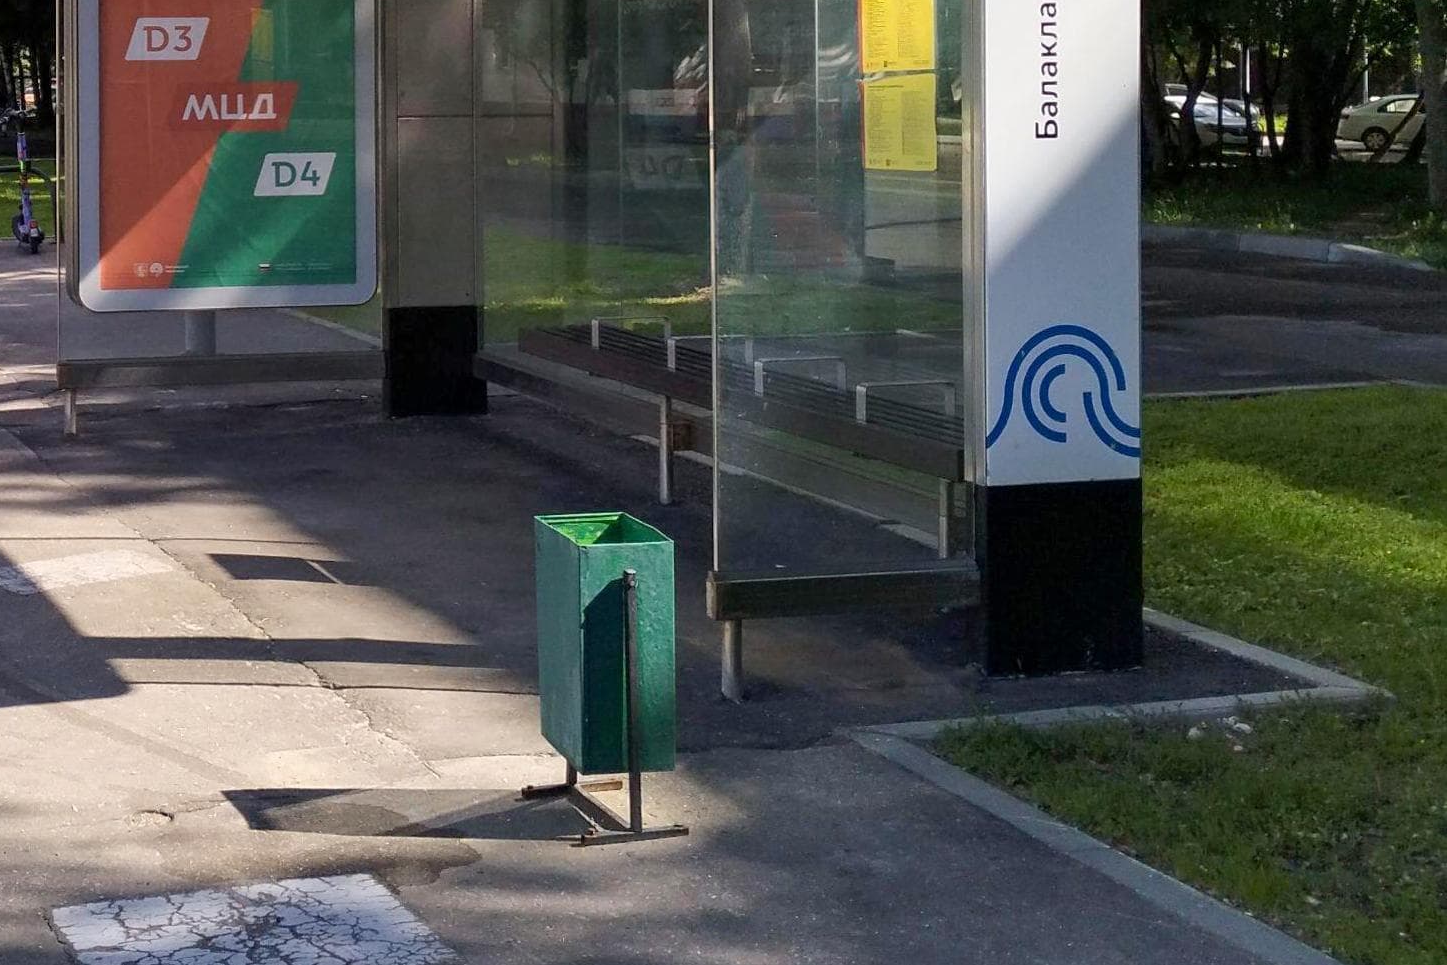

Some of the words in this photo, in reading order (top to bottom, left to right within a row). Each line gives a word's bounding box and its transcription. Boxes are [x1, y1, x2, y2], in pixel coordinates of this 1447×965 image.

[143, 25, 192, 52] D3
[182, 93, 277, 121] МЦД
[271, 161, 321, 188] D4
